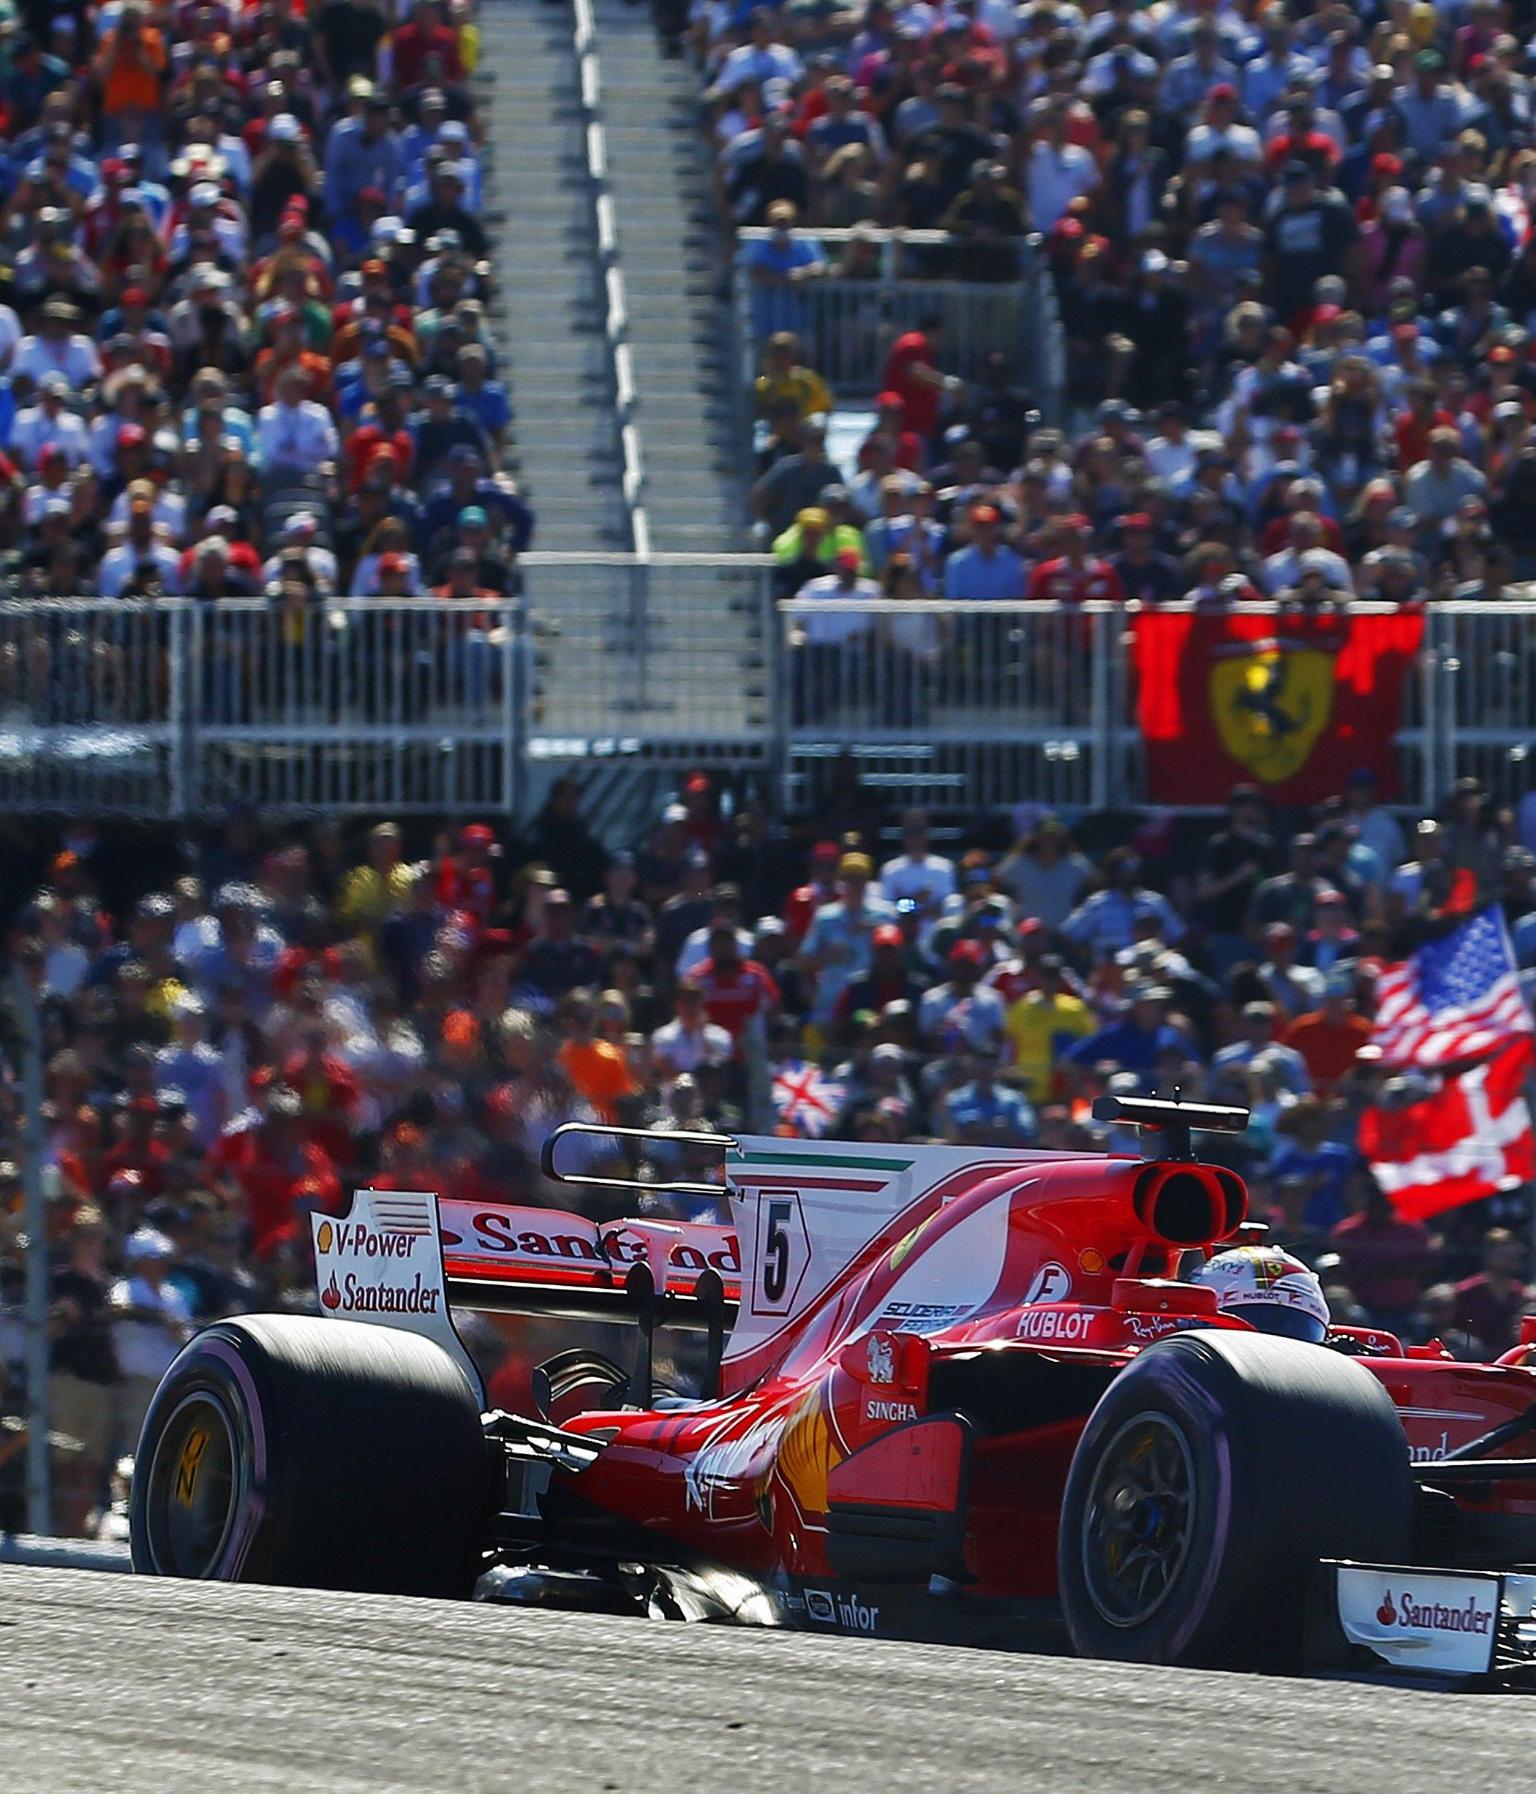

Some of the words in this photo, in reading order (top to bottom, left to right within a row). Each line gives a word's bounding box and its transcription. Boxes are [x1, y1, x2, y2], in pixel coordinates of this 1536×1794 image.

[335, 1223, 417, 1258] V-Power
[472, 1212, 742, 1273] Santand
[765, 1201, 792, 1303] 5
[342, 1272, 440, 1314] Santander
[1243, 1292, 1280, 1300] HUBLOT
[1016, 1312, 1095, 1340] HUBLOT
[1124, 1316, 1176, 1338] Ray-Ban
[867, 1400, 918, 1421] SINGHA
[837, 1593, 880, 1631] infor
[1398, 1592, 1493, 1634] Santander
